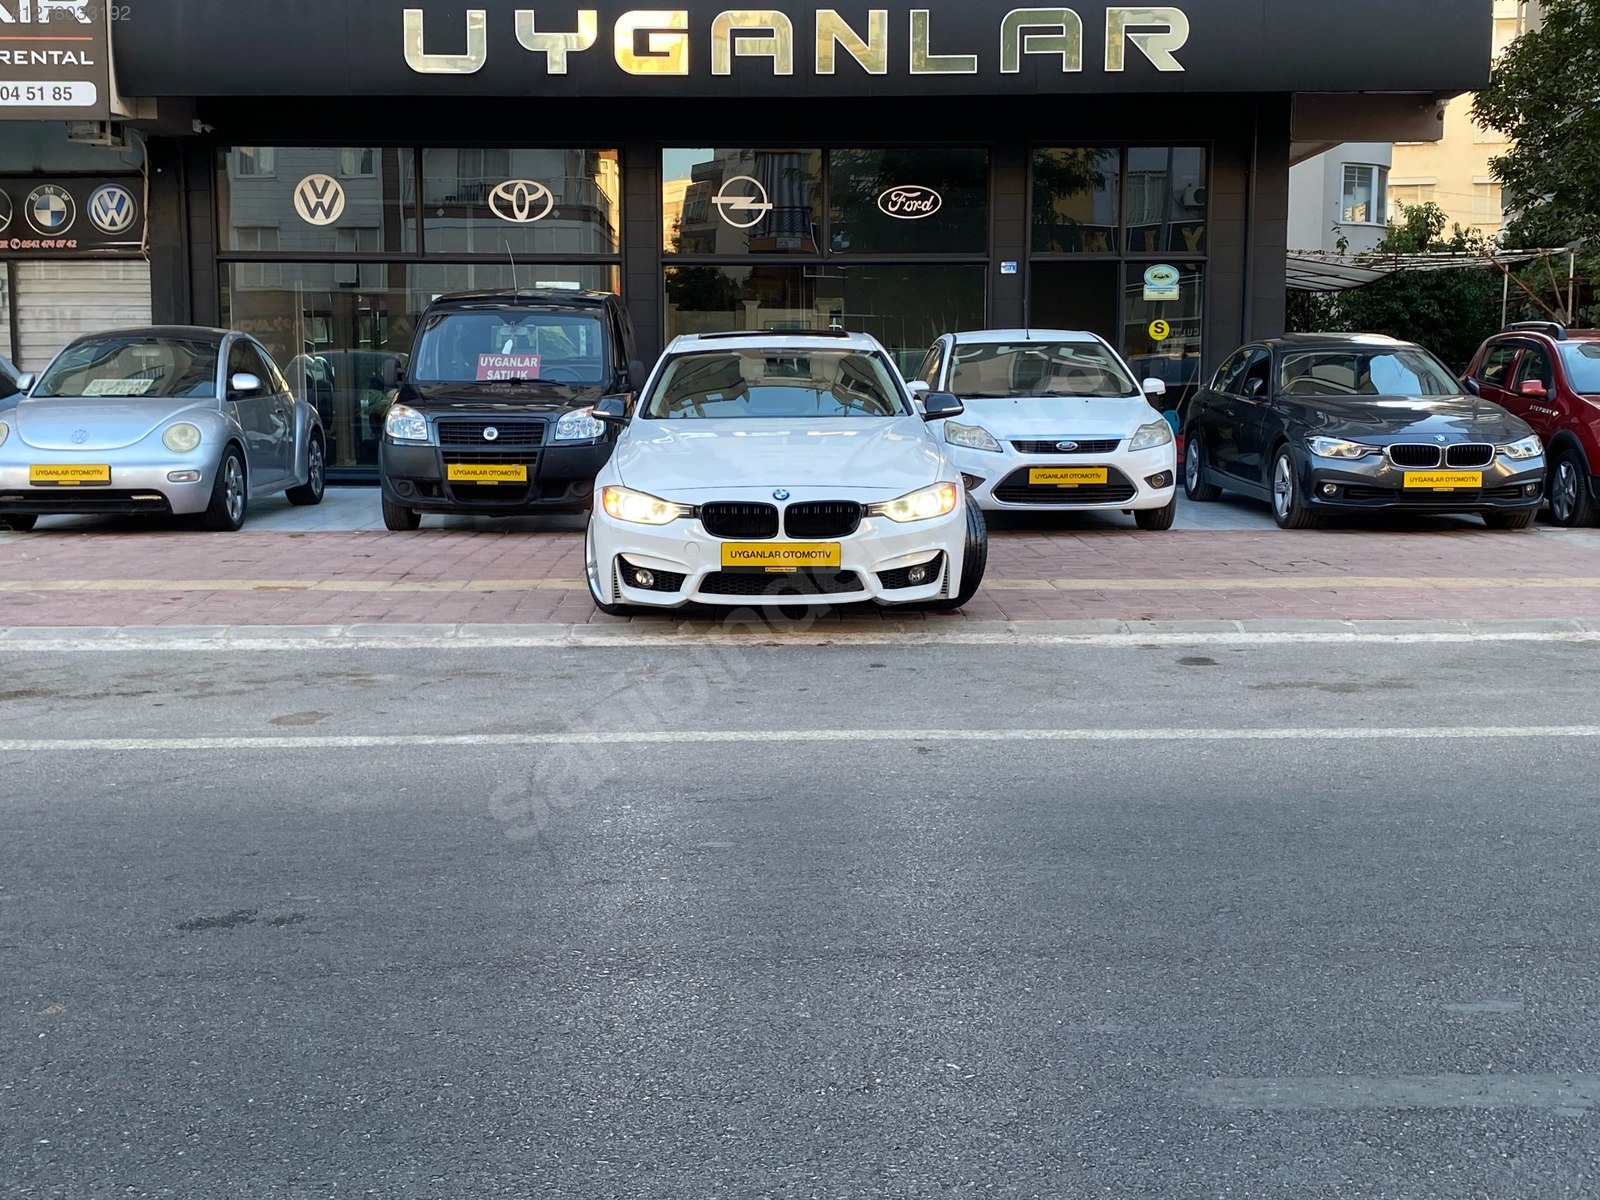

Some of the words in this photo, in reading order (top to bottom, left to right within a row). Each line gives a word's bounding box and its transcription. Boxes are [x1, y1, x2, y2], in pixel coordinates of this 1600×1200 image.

[0, 0, 92, 23] IR
[402, 6, 1191, 76] UYGANLAR
[0, 50, 95, 65] RENTAL
[26, 86, 44, 101] 51
[52, 86, 73, 101] 85
[888, 190, 935, 212] Ford
[1153, 321, 1165, 334] S
[480, 356, 538, 367] UYGANLAR
[730, 550, 781, 559] UYGANLAR
[782, 549, 832, 559] OTOMOTİV
